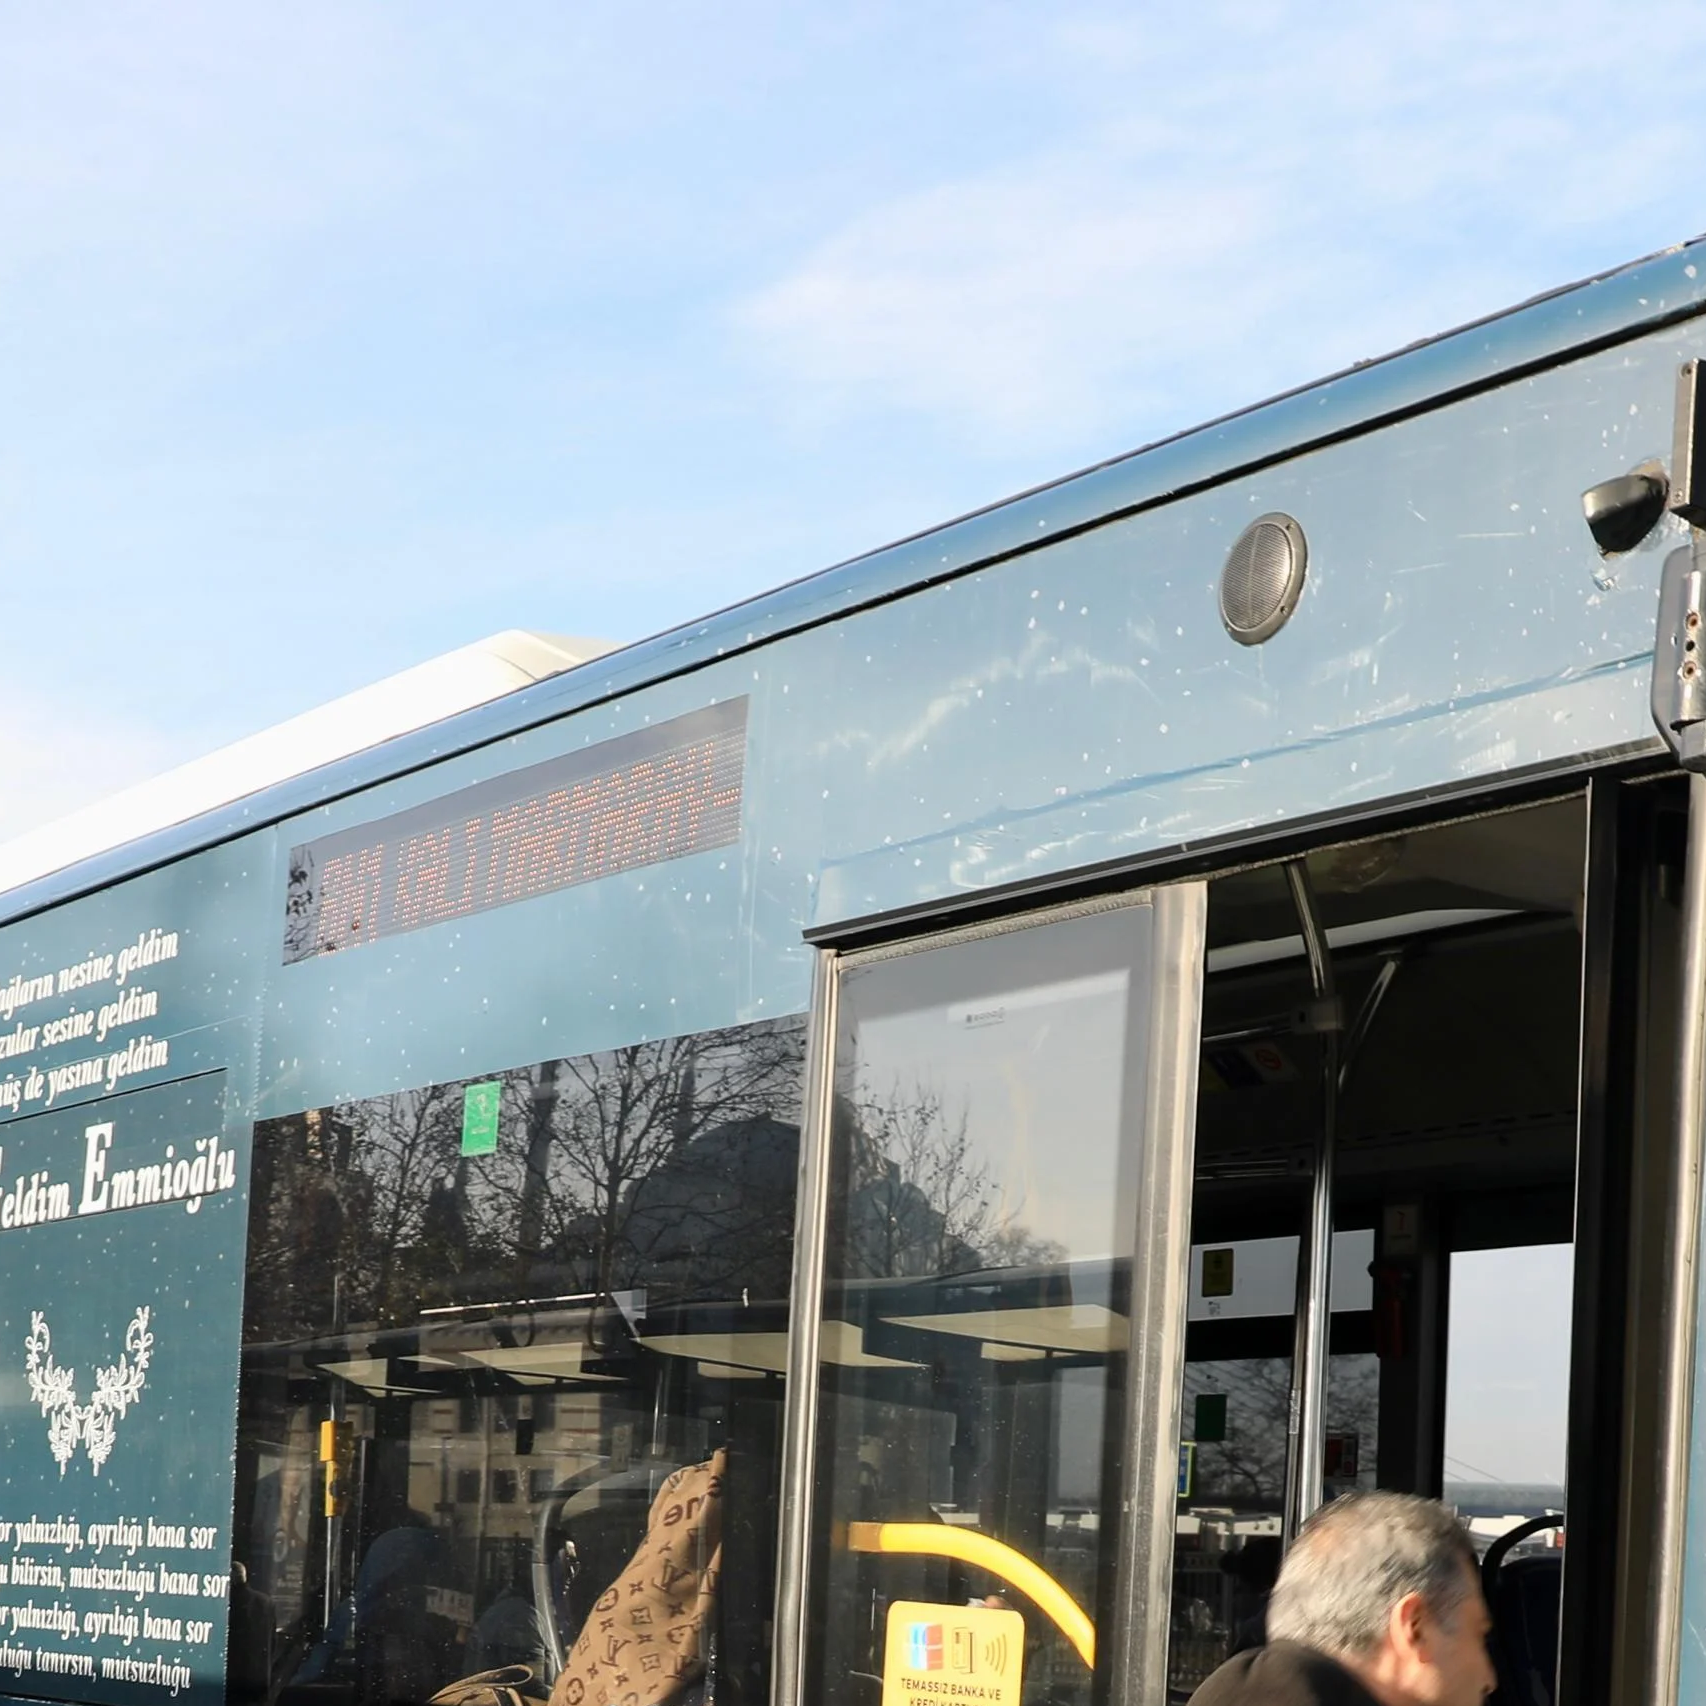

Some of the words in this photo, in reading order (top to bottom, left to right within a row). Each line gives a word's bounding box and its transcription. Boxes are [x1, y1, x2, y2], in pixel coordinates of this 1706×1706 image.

[58, 952, 114, 993] nesine
[115, 928, 179, 985] geldim
[42, 1007, 95, 1047] sesine
[96, 986, 158, 1042] geldim
[24, 1065, 44, 1101] de
[45, 1058, 104, 1106] yasına
[106, 1035, 168, 1091] geldim
[77, 1122, 236, 1215] Emmioğlu
[13, 1515, 84, 1554] yalnızlığı,
[88, 1516, 143, 1556] ayrılığı
[146, 1517, 187, 1549] bana
[189, 1526, 218, 1550] sor
[11, 1557, 66, 1592] bilirsin,
[69, 1560, 156, 1602] mutsuzluğu
[158, 1563, 199, 1596] bana
[202, 1574, 231, 1599] sor
[9, 1599, 80, 1641] yalnızlığı,
[83, 1605, 140, 1646] ayrılığı
[142, 1608, 182, 1641] bana
[185, 1620, 213, 1645] sor
[35, 1646, 97, 1683] tanırsın,
[101, 1654, 192, 1697] mutsuzluğu
[901, 1676, 949, 1695] TEMASSIZ
[951, 1684, 986, 1699] BANKA
[988, 1687, 1001, 1701] VE
